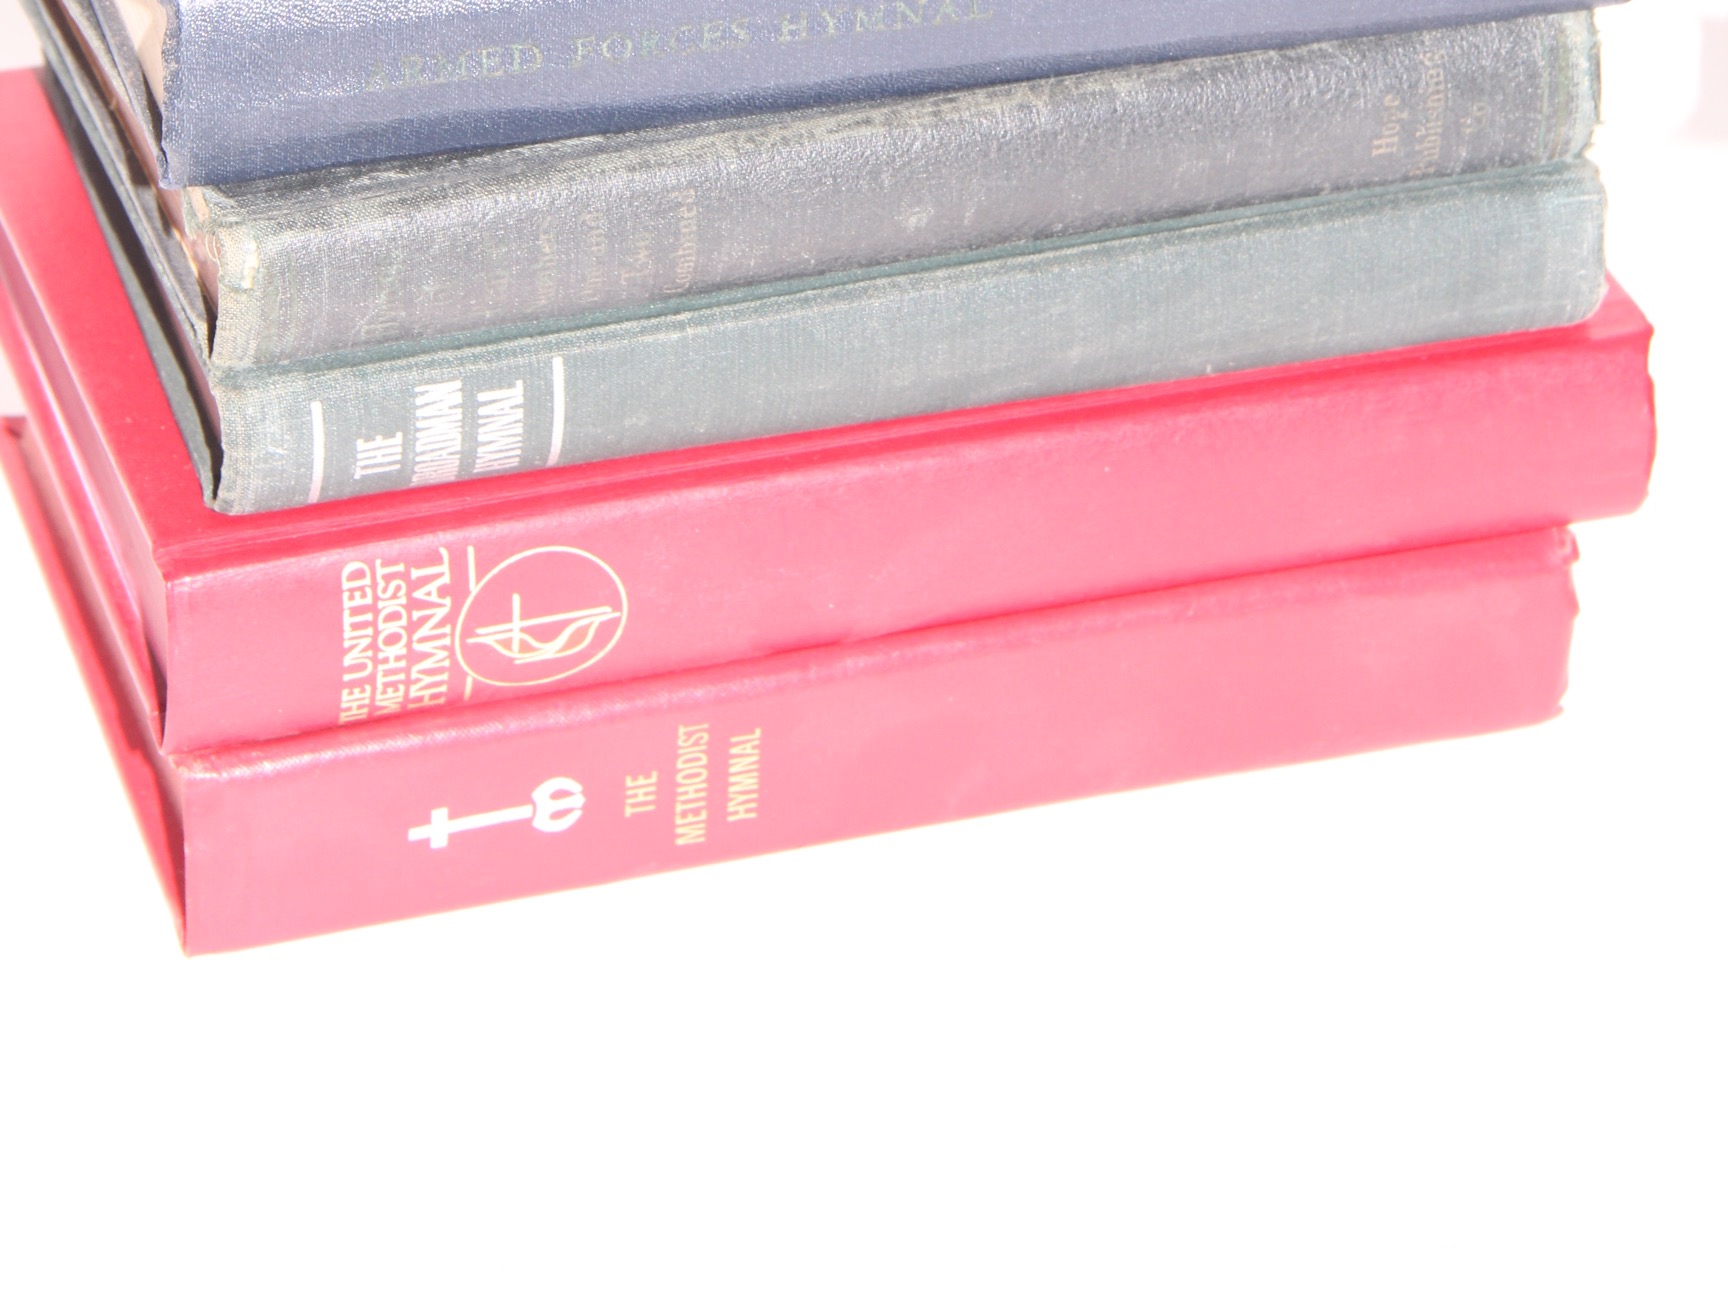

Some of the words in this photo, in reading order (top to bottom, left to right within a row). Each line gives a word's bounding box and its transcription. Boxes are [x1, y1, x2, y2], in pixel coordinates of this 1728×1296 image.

[367, 44, 543, 92] ARMED
[571, 17, 750, 68] FORCES
[1371, 92, 1408, 158] Hope
[354, 431, 403, 480] THE
[472, 379, 524, 473] HYMNAL
[341, 561, 374, 682] UNITED
[373, 558, 408, 716] METHODIST
[407, 547, 452, 709] HYMNAL
[338, 684, 371, 724] THE
[624, 770, 658, 818] THE
[674, 723, 709, 845] METHODIST
[726, 727, 761, 822] HYMNAL
